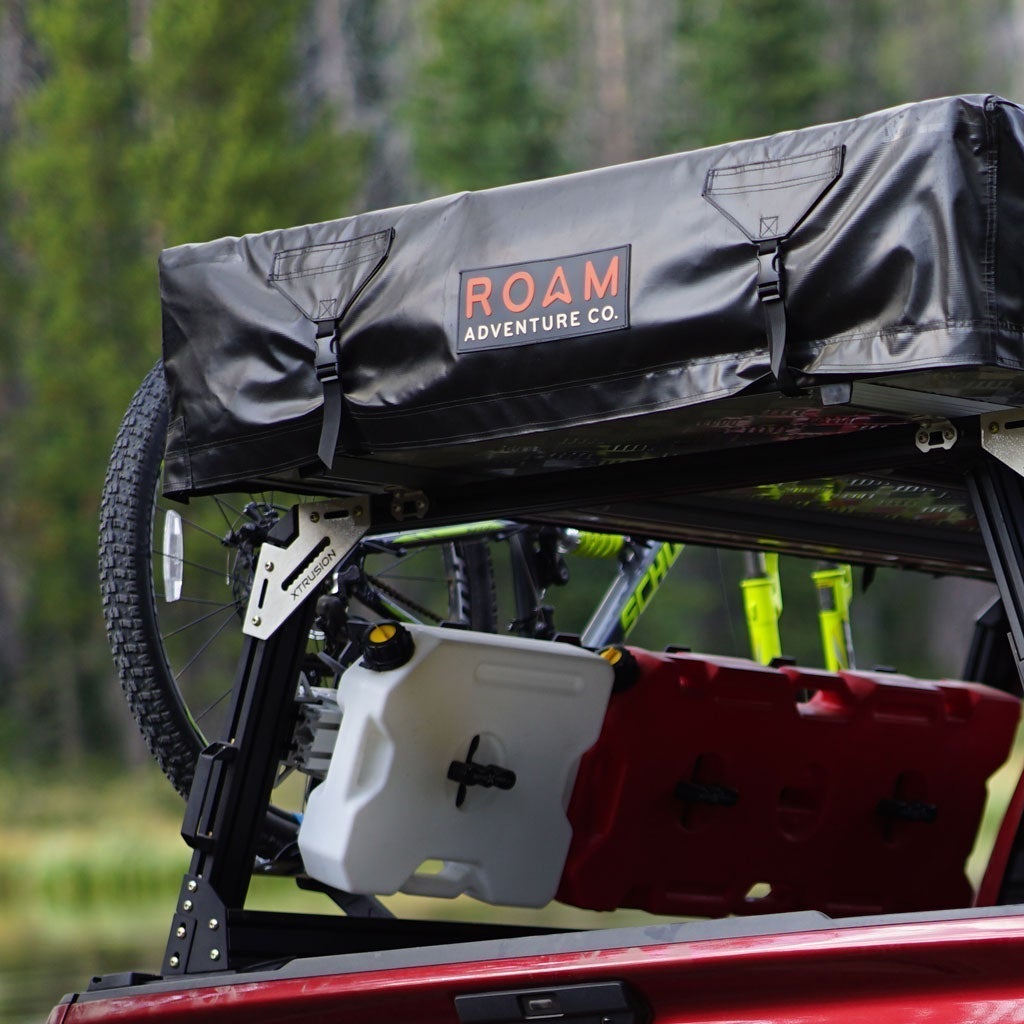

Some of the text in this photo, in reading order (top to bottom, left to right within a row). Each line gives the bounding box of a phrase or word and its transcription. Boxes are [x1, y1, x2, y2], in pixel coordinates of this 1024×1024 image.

[465, 256, 619, 318] ROAM
[464, 305, 619, 342] ADVENTURE CO.
[290, 548, 337, 601] XTRUSION
